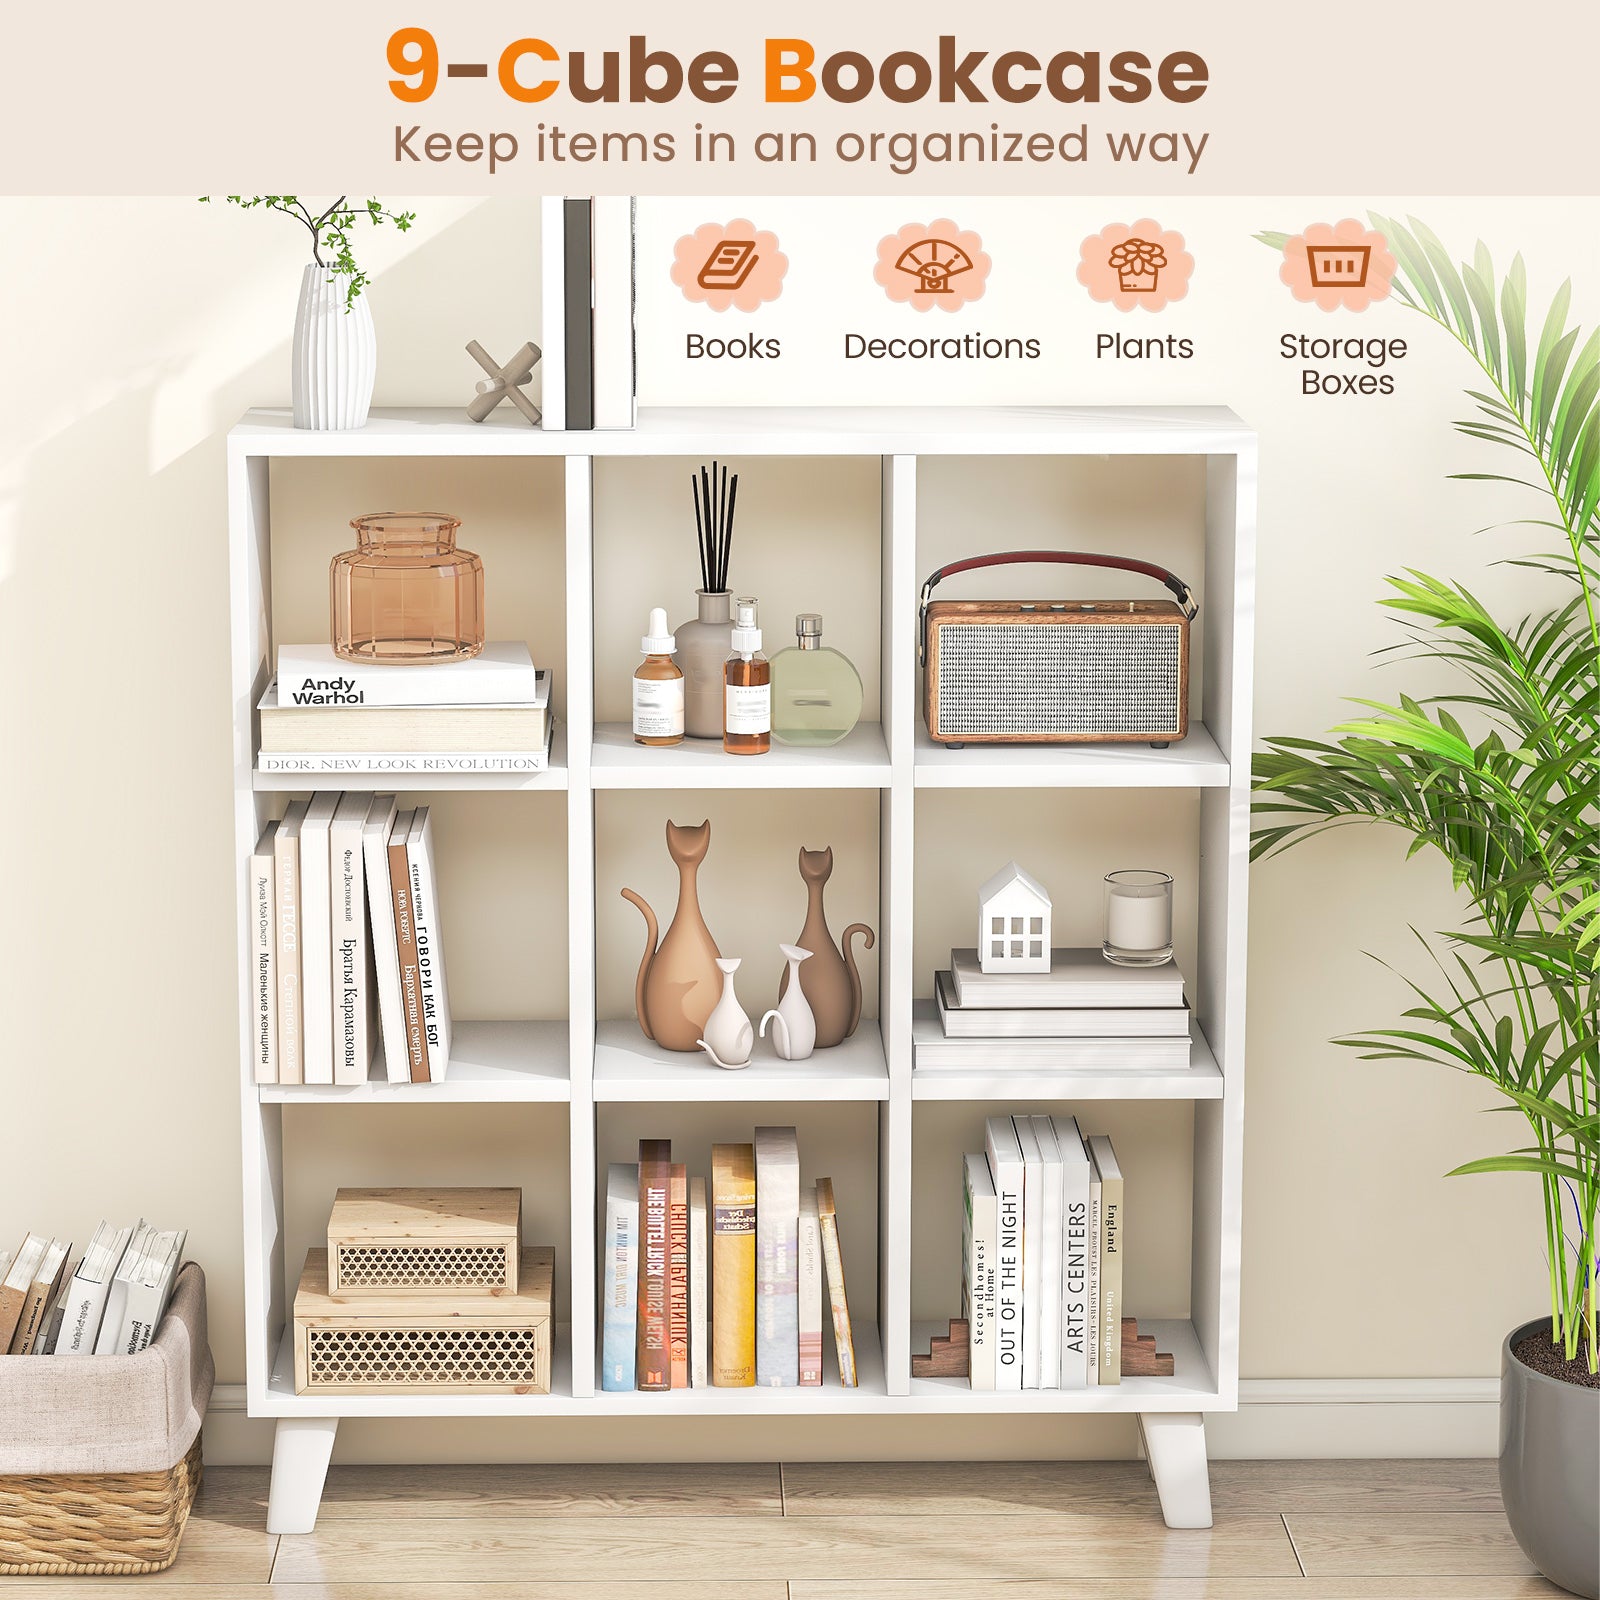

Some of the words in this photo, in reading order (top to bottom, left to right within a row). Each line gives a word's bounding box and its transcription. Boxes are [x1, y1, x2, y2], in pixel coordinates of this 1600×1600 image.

[292, 690, 364, 705] Warhol
[302, 677, 356, 692] Andy
[321, 759, 362, 770] NEW
[367, 759, 416, 770] LOOK
[422, 759, 540, 770] REVOLUTION
[412, 863, 421, 892] КСЕНИЯ
[397, 889, 408, 910] НОРА
[259, 920, 268, 946] Олкотт
[282, 904, 297, 953] ГЕССЕ
[338, 939, 357, 984] Братья
[416, 926, 433, 989] ГОВОРИ
[259, 953, 270, 1012] Маленькие
[402, 965, 419, 1025] Бархатная
[423, 994, 436, 1018] КАК
[259, 1013, 270, 1064] женщины
[340, 987, 358, 1067] Карамазовы
[427, 1024, 439, 1048] БОГ
[408, 1026, 425, 1066] смерть
[1002, 1191, 1018, 1248] NIGHT
[1105, 1204, 1118, 1254] England
[1068, 1202, 1086, 1294] CENTERS
[987, 1268, 995, 1303] Home
[1001, 1256, 1017, 1290] THE
[987, 1305, 995, 1318] at
[1001, 1297, 1016, 1321] OF
[1105, 1291, 1115, 1323] United
[1000, 1328, 1016, 1365] OUT
[1067, 1303, 1085, 1354] ARTS
[1104, 1324, 1115, 1366] Kingdom
